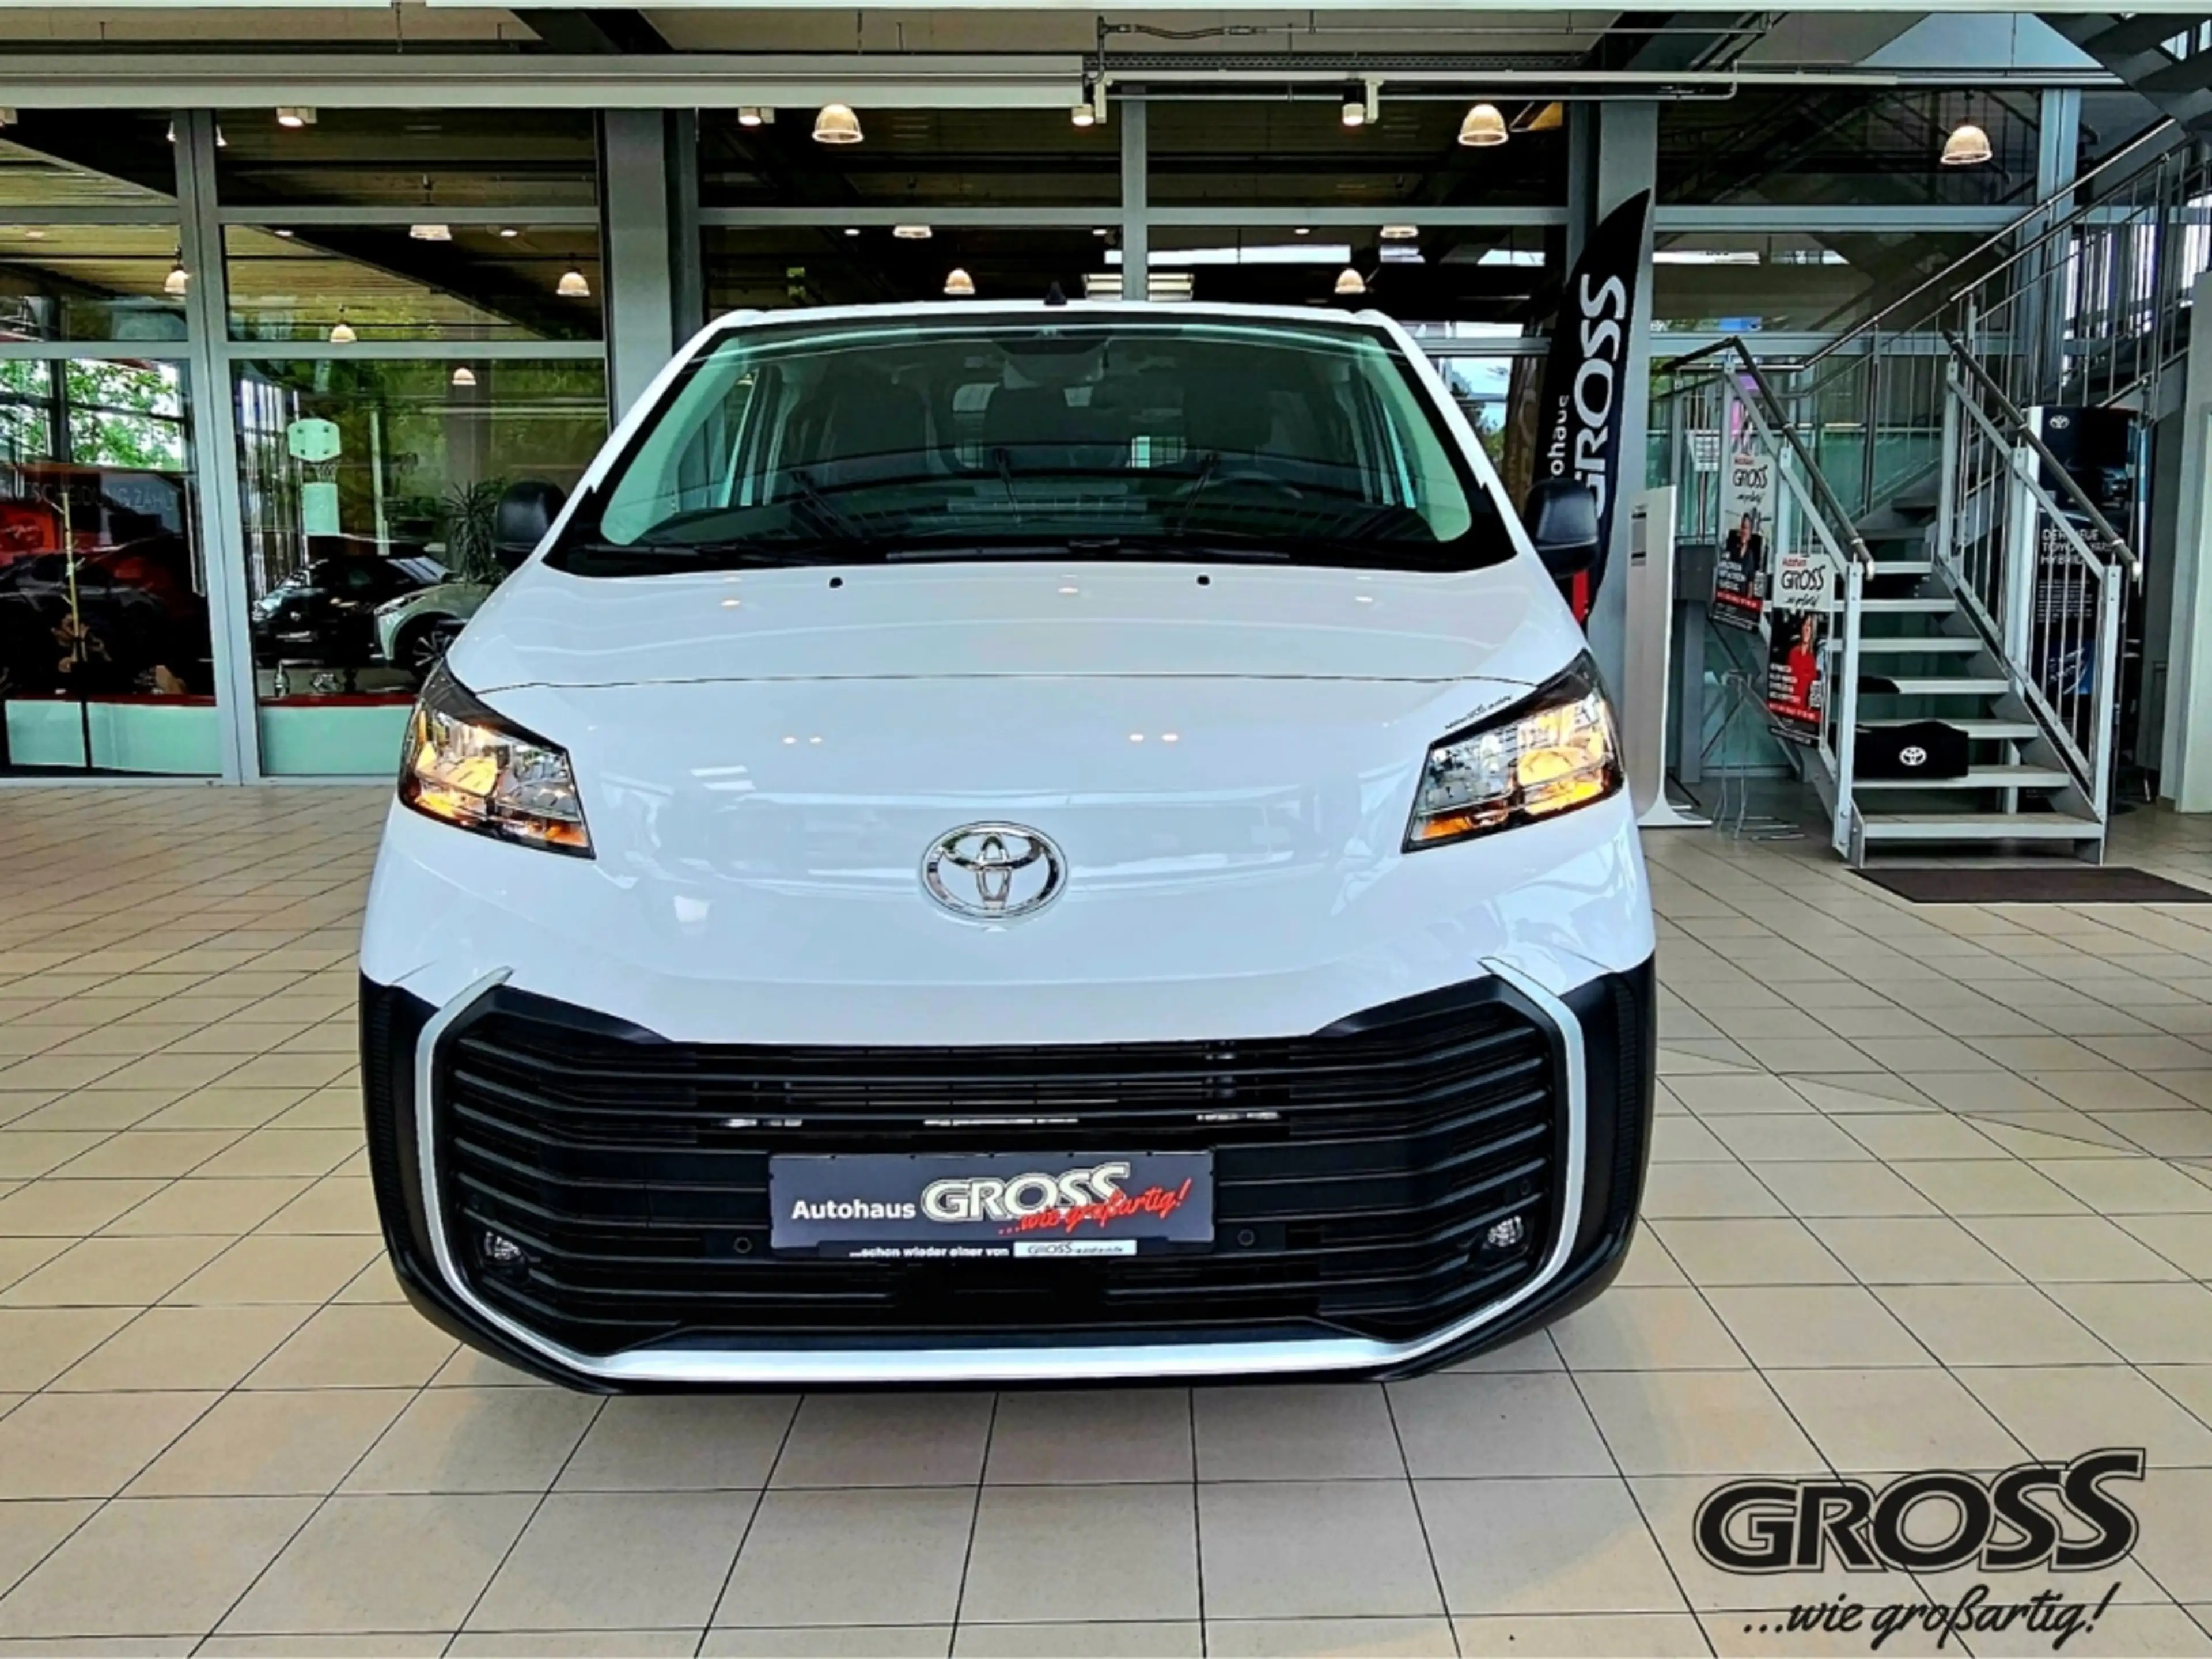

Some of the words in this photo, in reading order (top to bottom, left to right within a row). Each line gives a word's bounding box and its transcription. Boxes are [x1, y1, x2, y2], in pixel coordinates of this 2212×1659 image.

[1781, 564, 1827, 591] GROSS
[791, 1199, 917, 1220] Autohaus
[921, 1161, 1131, 1223] GROSS
[903, 1245, 946, 1258] wieder
[948, 1246, 983, 1257] einer
[985, 1247, 1009, 1257] von
